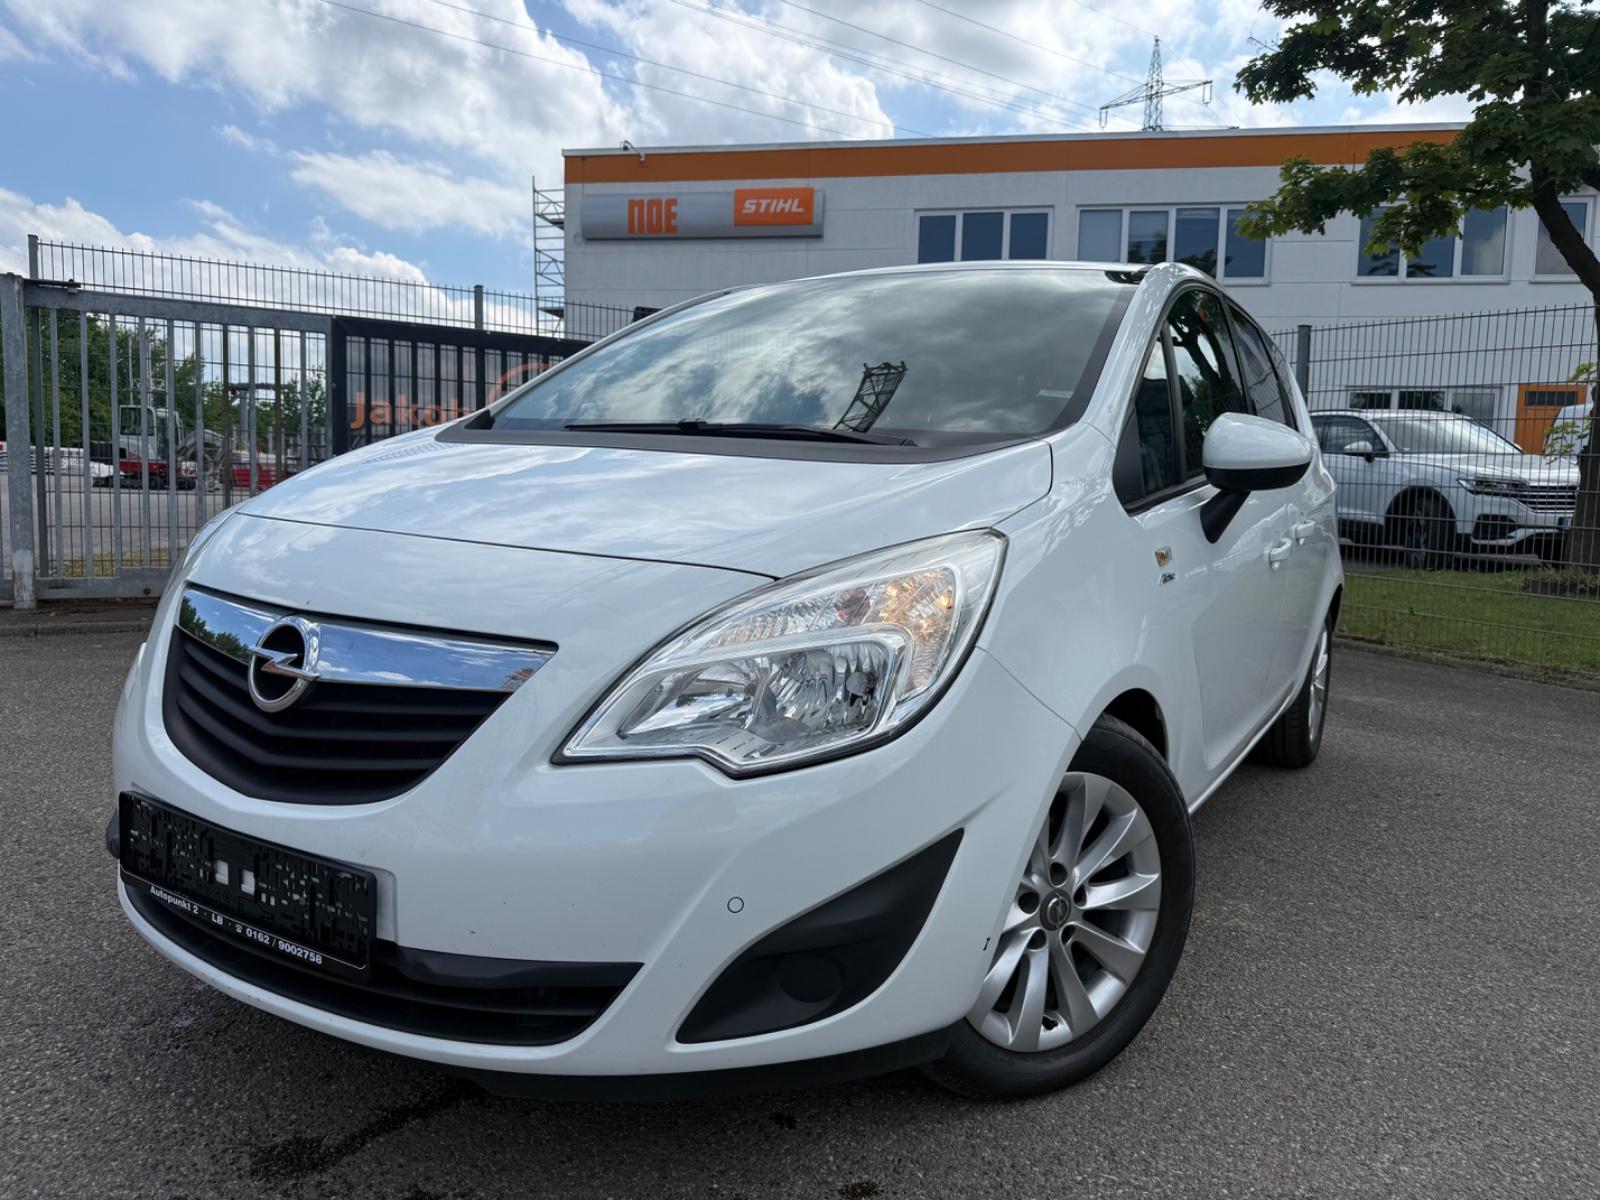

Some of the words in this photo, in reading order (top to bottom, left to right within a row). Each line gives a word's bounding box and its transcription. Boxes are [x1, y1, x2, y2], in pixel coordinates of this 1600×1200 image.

[742, 198, 805, 214] STIHL
[150, 885, 191, 911] Autopunkt
[193, 905, 199, 915] 2
[211, 912, 224, 925] LB
[246, 927, 270, 944] 0162
[278, 940, 323, 964] 9002758
